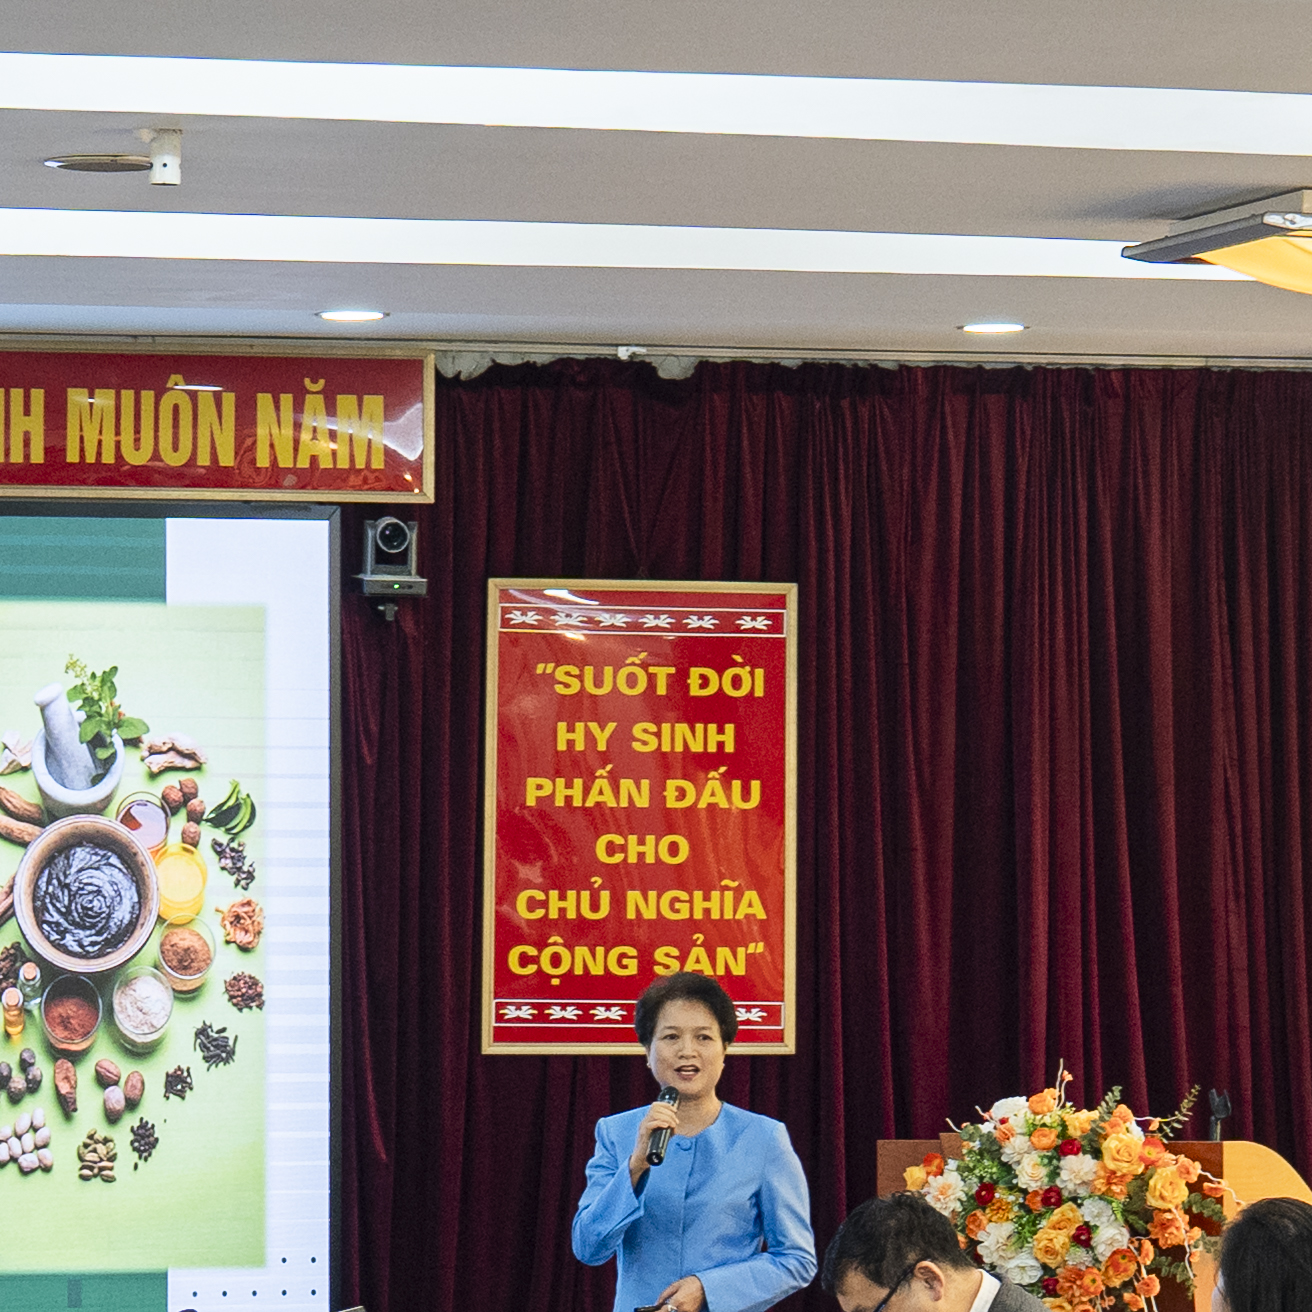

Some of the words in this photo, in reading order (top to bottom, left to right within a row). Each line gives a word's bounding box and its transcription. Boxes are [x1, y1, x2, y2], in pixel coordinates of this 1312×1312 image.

[67, 374, 236, 467] MUÔN
[256, 377, 385, 470] NĂM
[687, 655, 765, 698] ĐỜI
[557, 722, 617, 752] HY
[632, 722, 735, 753] SINH
[526, 764, 651, 808] PHẤN
[664, 766, 761, 810] ĐẤU
[595, 834, 690, 865] CHO
[516, 877, 611, 920] CHỦ
[627, 879, 767, 920] NGHĨA
[508, 936, 638, 985] CỘNG
